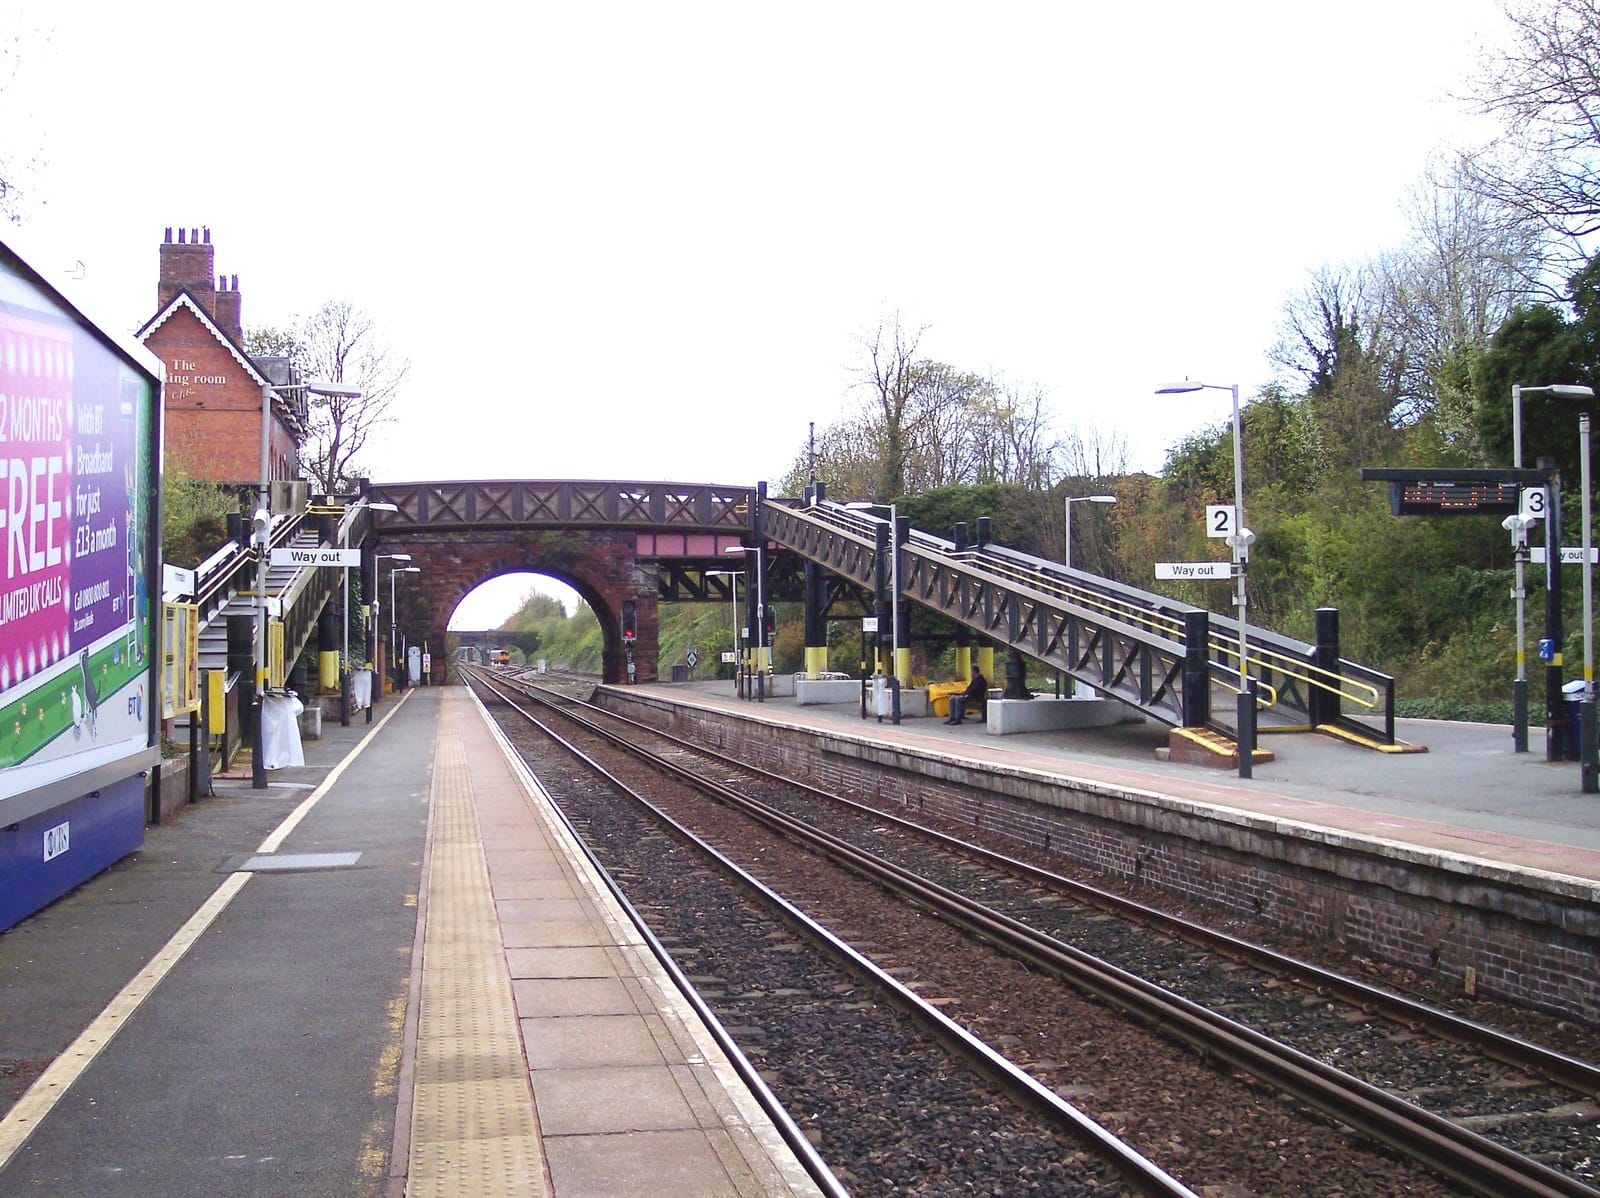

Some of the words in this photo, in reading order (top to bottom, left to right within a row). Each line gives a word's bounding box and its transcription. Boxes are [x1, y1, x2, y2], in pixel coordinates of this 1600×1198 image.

[172, 360, 196, 371] The
[165, 373, 190, 386] ing
[194, 375, 227, 385] room
[11, 395, 63, 442] MONTHS
[77, 402, 94, 435] With
[95, 404, 104, 435] BT
[77, 442, 113, 476] Broadband
[76, 484, 87, 517] for
[87, 484, 101, 523] just
[1529, 492, 1544, 513] 3
[0, 456, 63, 579] FREE
[1214, 510, 1229, 532] 2
[90, 531, 96, 554] a
[96, 517, 117, 552] month
[291, 551, 318, 564] Way
[321, 551, 341, 562] out
[1568, 551, 1584, 560] out
[1172, 565, 1195, 577] Way
[1197, 565, 1214, 575] out
[30, 582, 41, 614] UK
[42, 576, 62, 609] CALLS
[128, 696, 136, 716] BT
